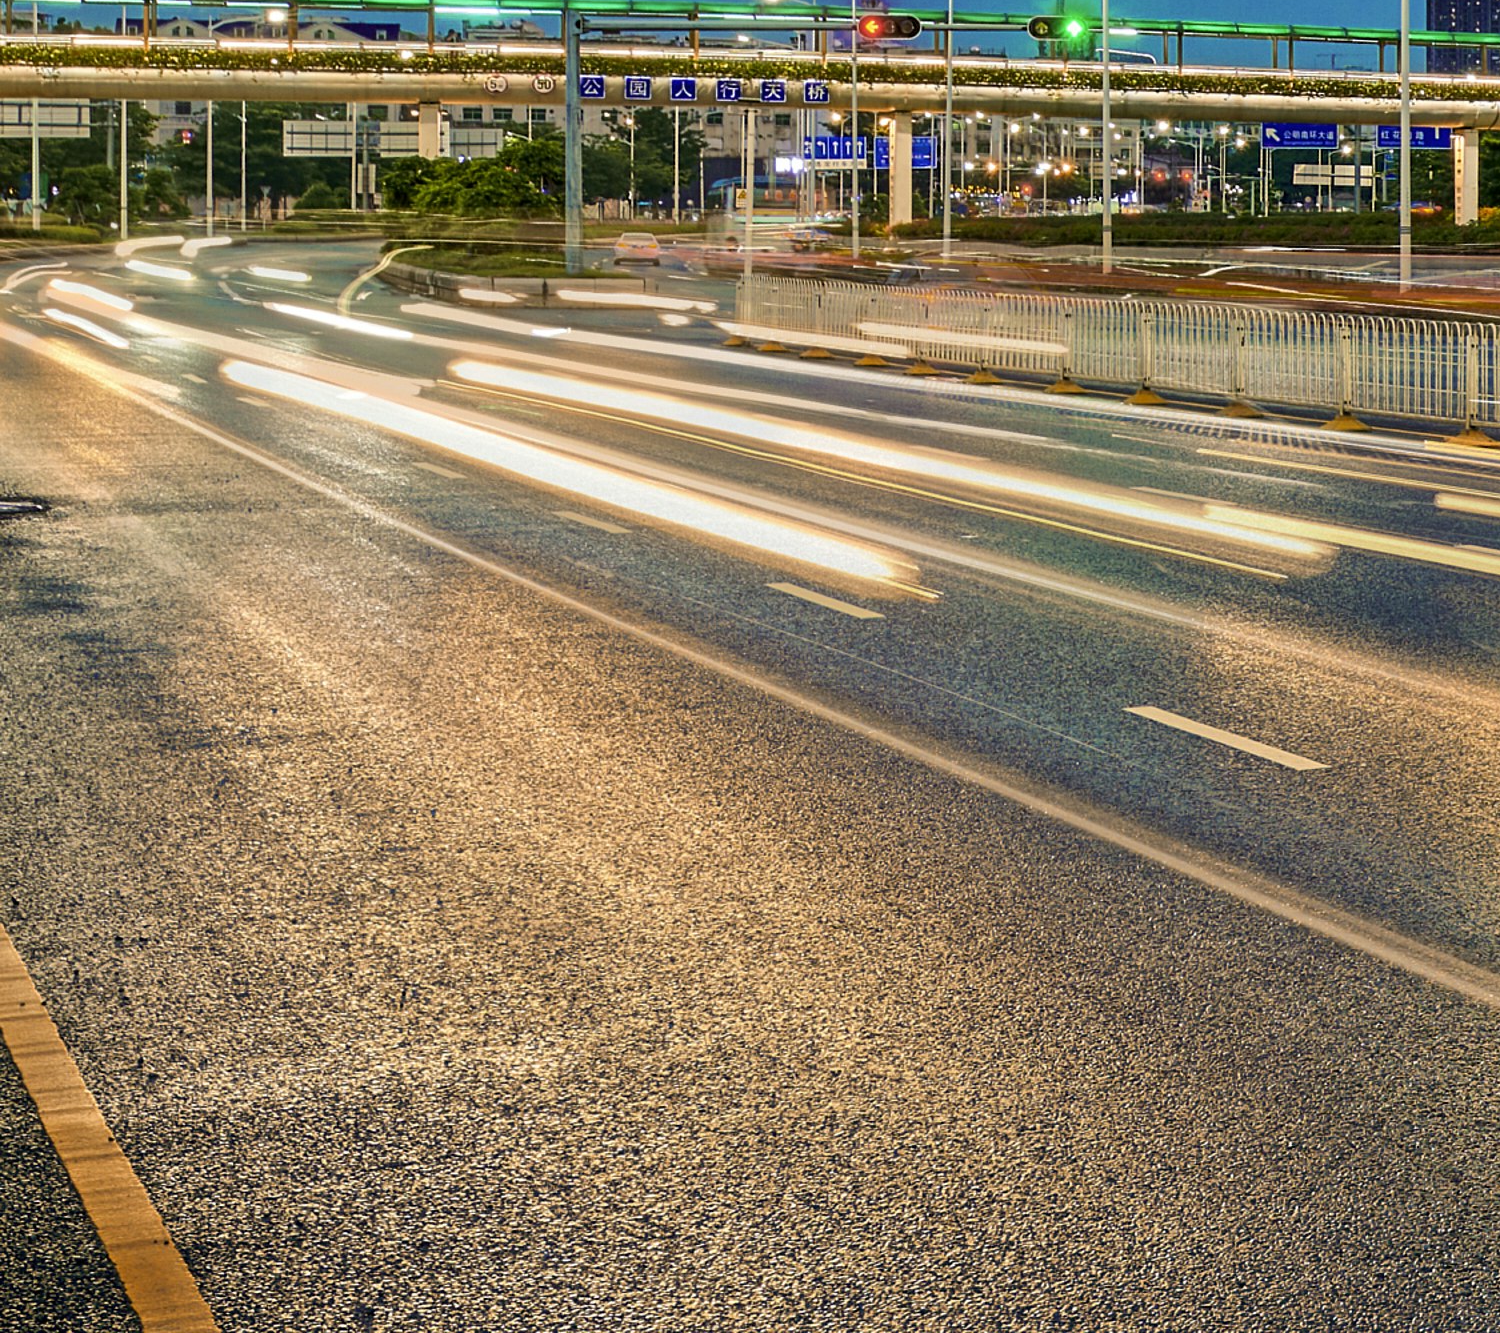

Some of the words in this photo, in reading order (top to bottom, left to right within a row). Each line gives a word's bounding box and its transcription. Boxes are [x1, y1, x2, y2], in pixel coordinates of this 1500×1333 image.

[537, 80, 551, 89] 50
[583, 79, 825, 100] 公园人行天桥
